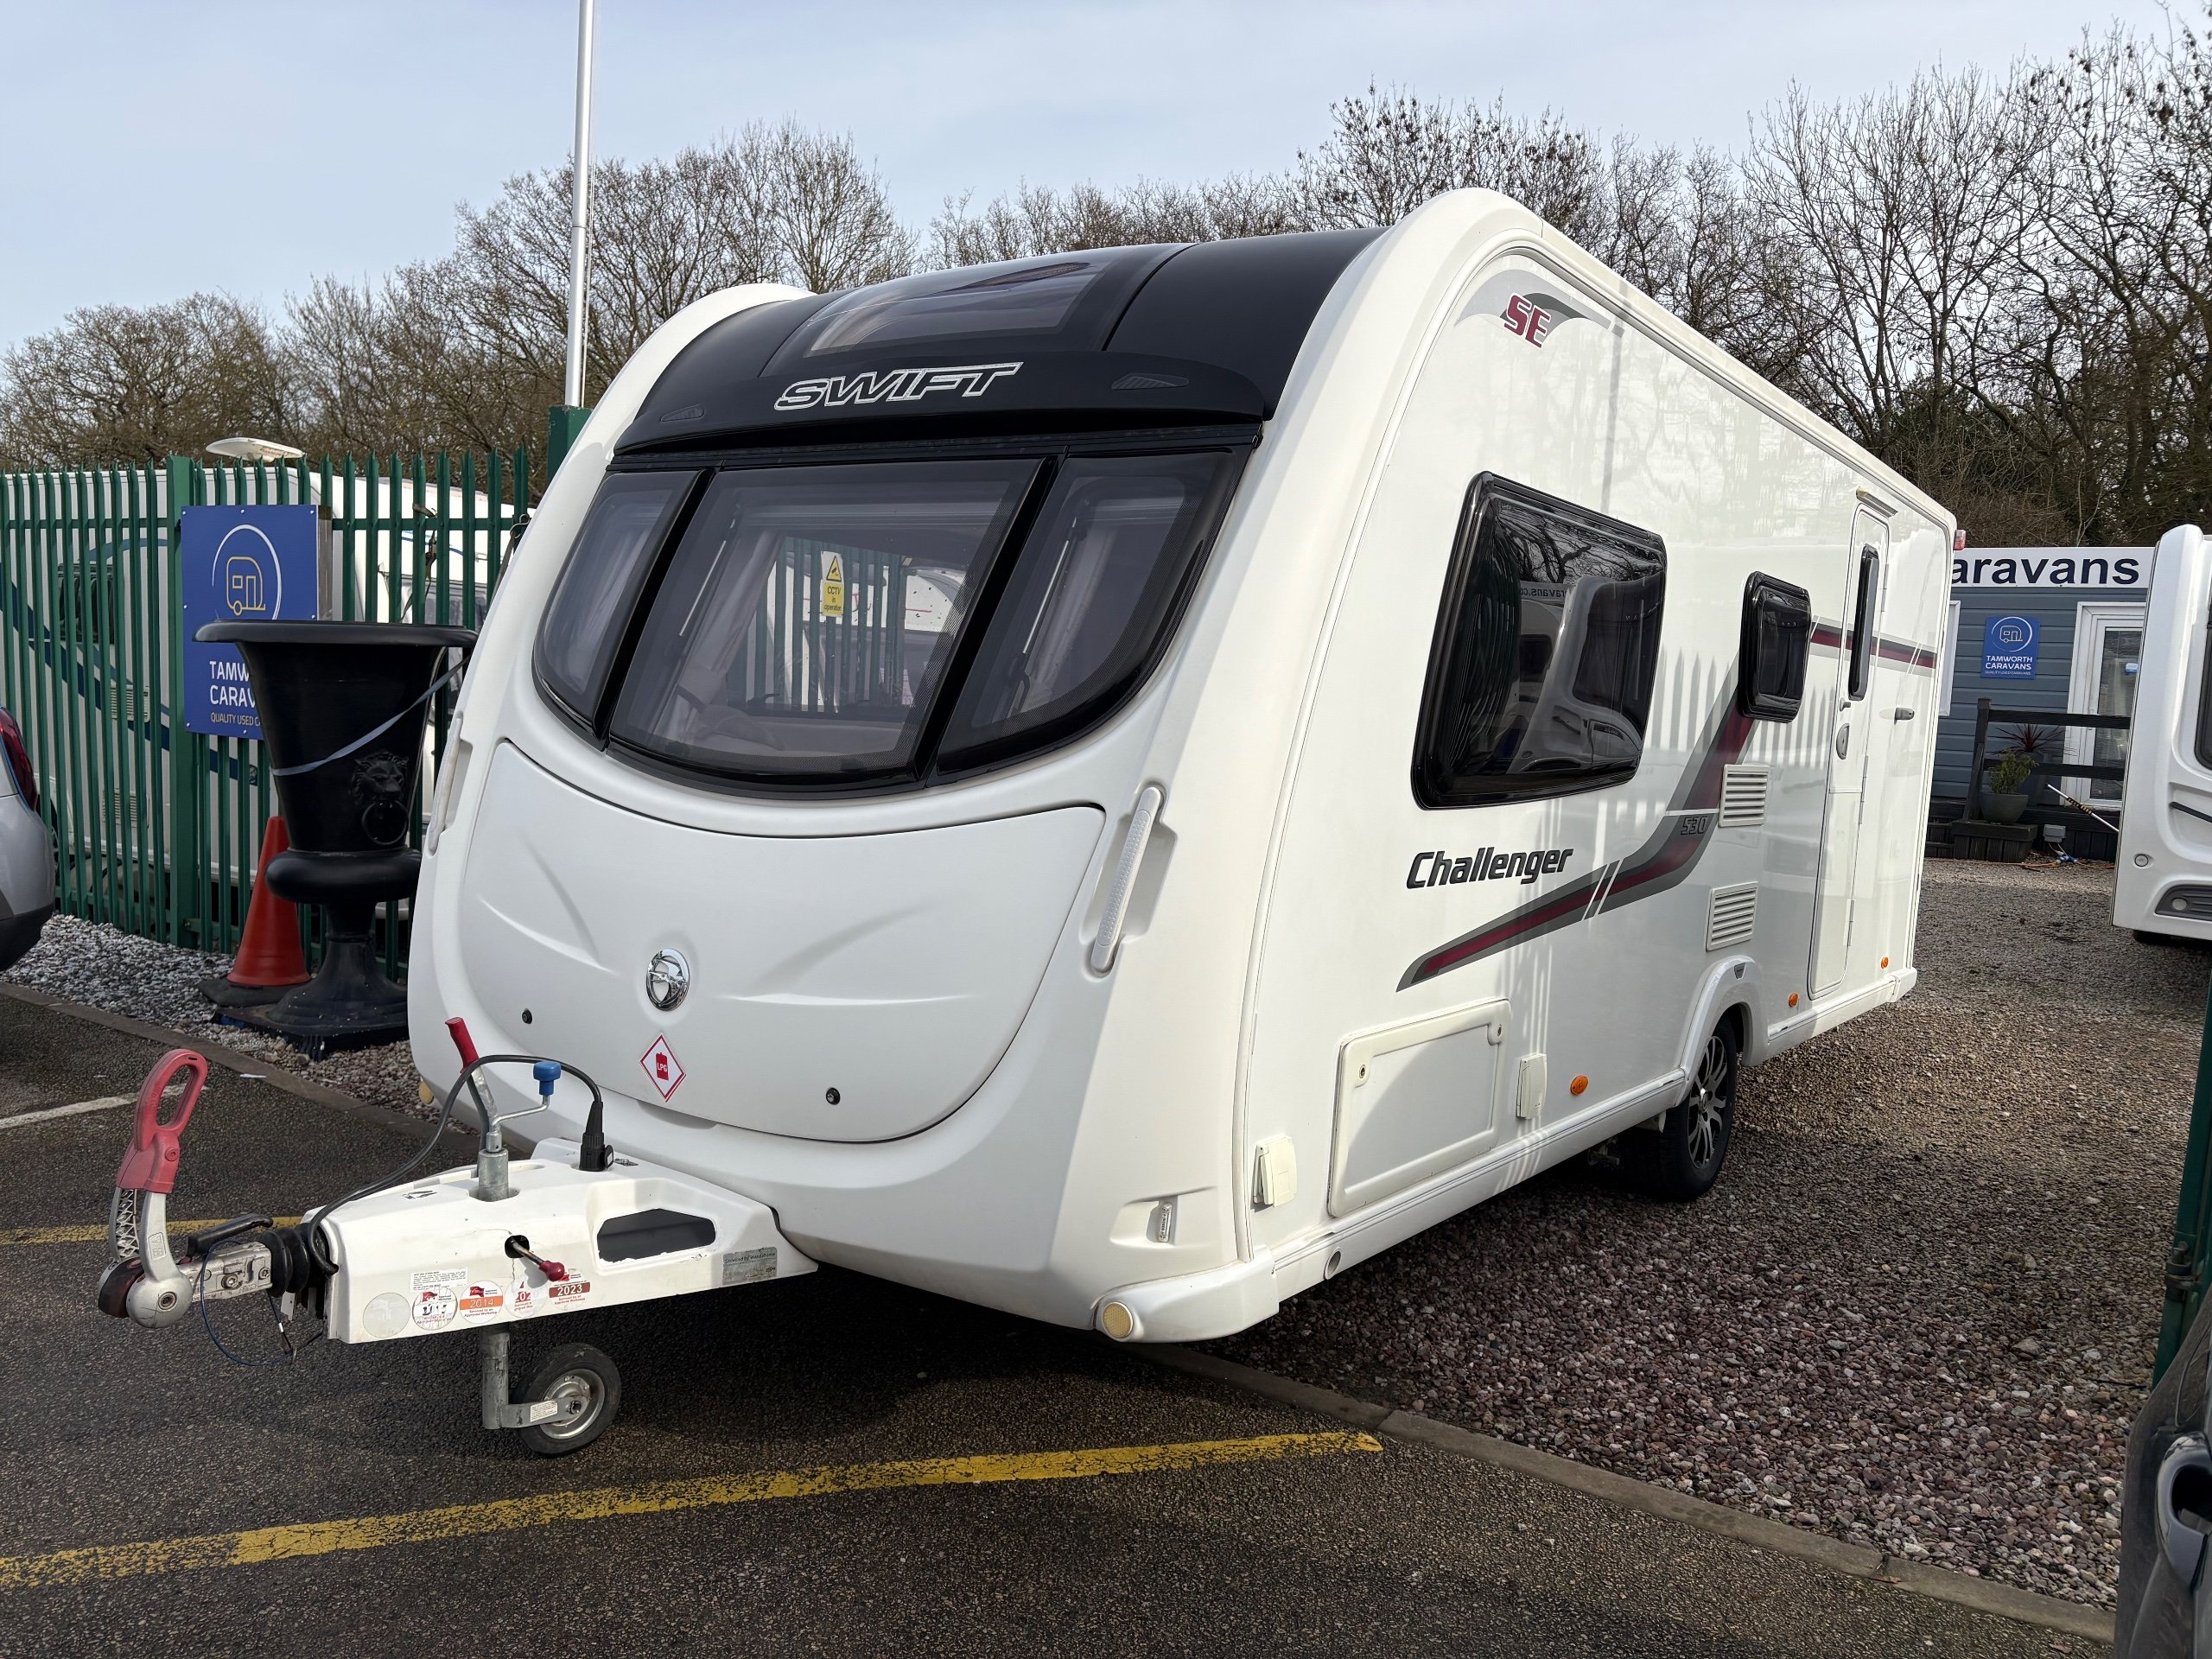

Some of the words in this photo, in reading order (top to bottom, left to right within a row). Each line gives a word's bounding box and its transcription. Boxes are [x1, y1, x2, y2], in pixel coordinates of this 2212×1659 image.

[1503, 292, 1552, 350] SE
[773, 361, 1025, 410] SWIFT
[1951, 557, 2140, 585] aravans
[827, 586, 842, 595] CCTV
[209, 661, 250, 682] TAMW
[1985, 662, 2032, 671] CARAVANS
[210, 684, 256, 709] CARAV
[211, 712, 236, 723] QUALITY
[238, 715, 253, 725] USED
[1680, 816, 1708, 836] 530
[1406, 847, 1574, 889] Challenger
[657, 1063, 668, 1072] LPG
[556, 1284, 582, 1296] 2023
[470, 1298, 493, 1308] 2014
